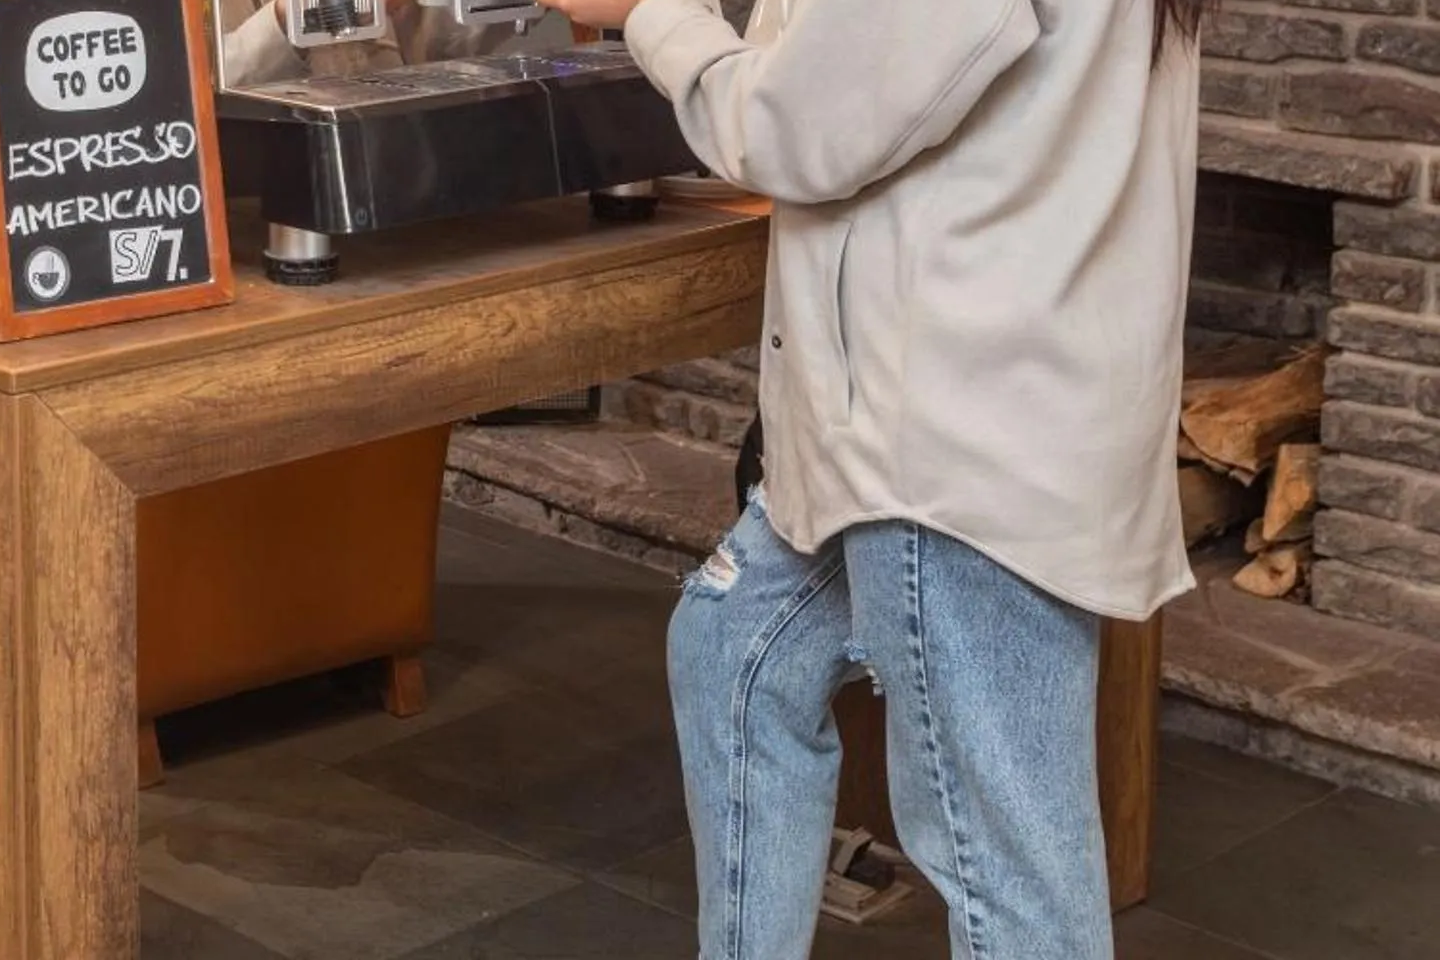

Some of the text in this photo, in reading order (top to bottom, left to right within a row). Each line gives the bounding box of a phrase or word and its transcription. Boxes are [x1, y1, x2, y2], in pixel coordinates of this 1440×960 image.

[37, 27, 137, 64] COFFEE
[53, 64, 131, 99] TO GO
[8, 121, 196, 180] ESPRESSO
[5, 184, 201, 236] AMERICANO
